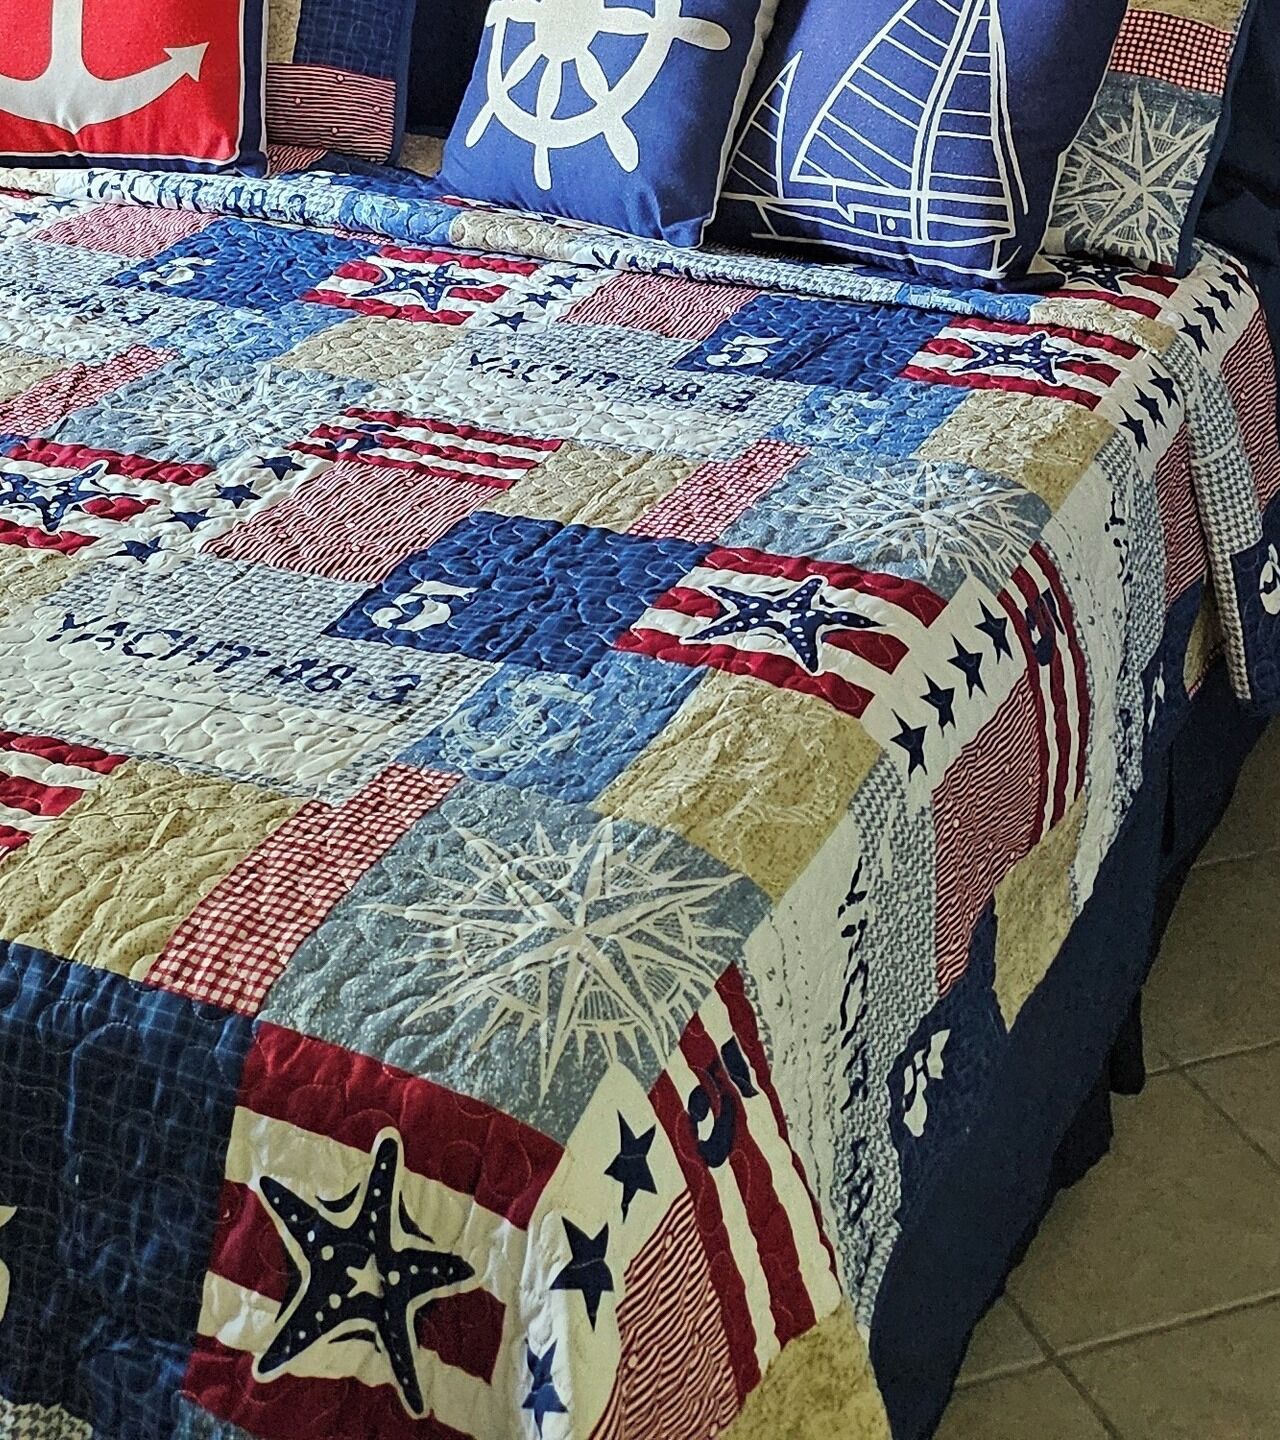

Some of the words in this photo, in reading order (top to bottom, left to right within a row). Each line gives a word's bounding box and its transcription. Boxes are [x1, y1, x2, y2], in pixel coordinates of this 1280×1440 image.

[706, 335, 784, 367] 5
[371, 578, 480, 633] 5
[46, 612, 271, 674] YACHT
